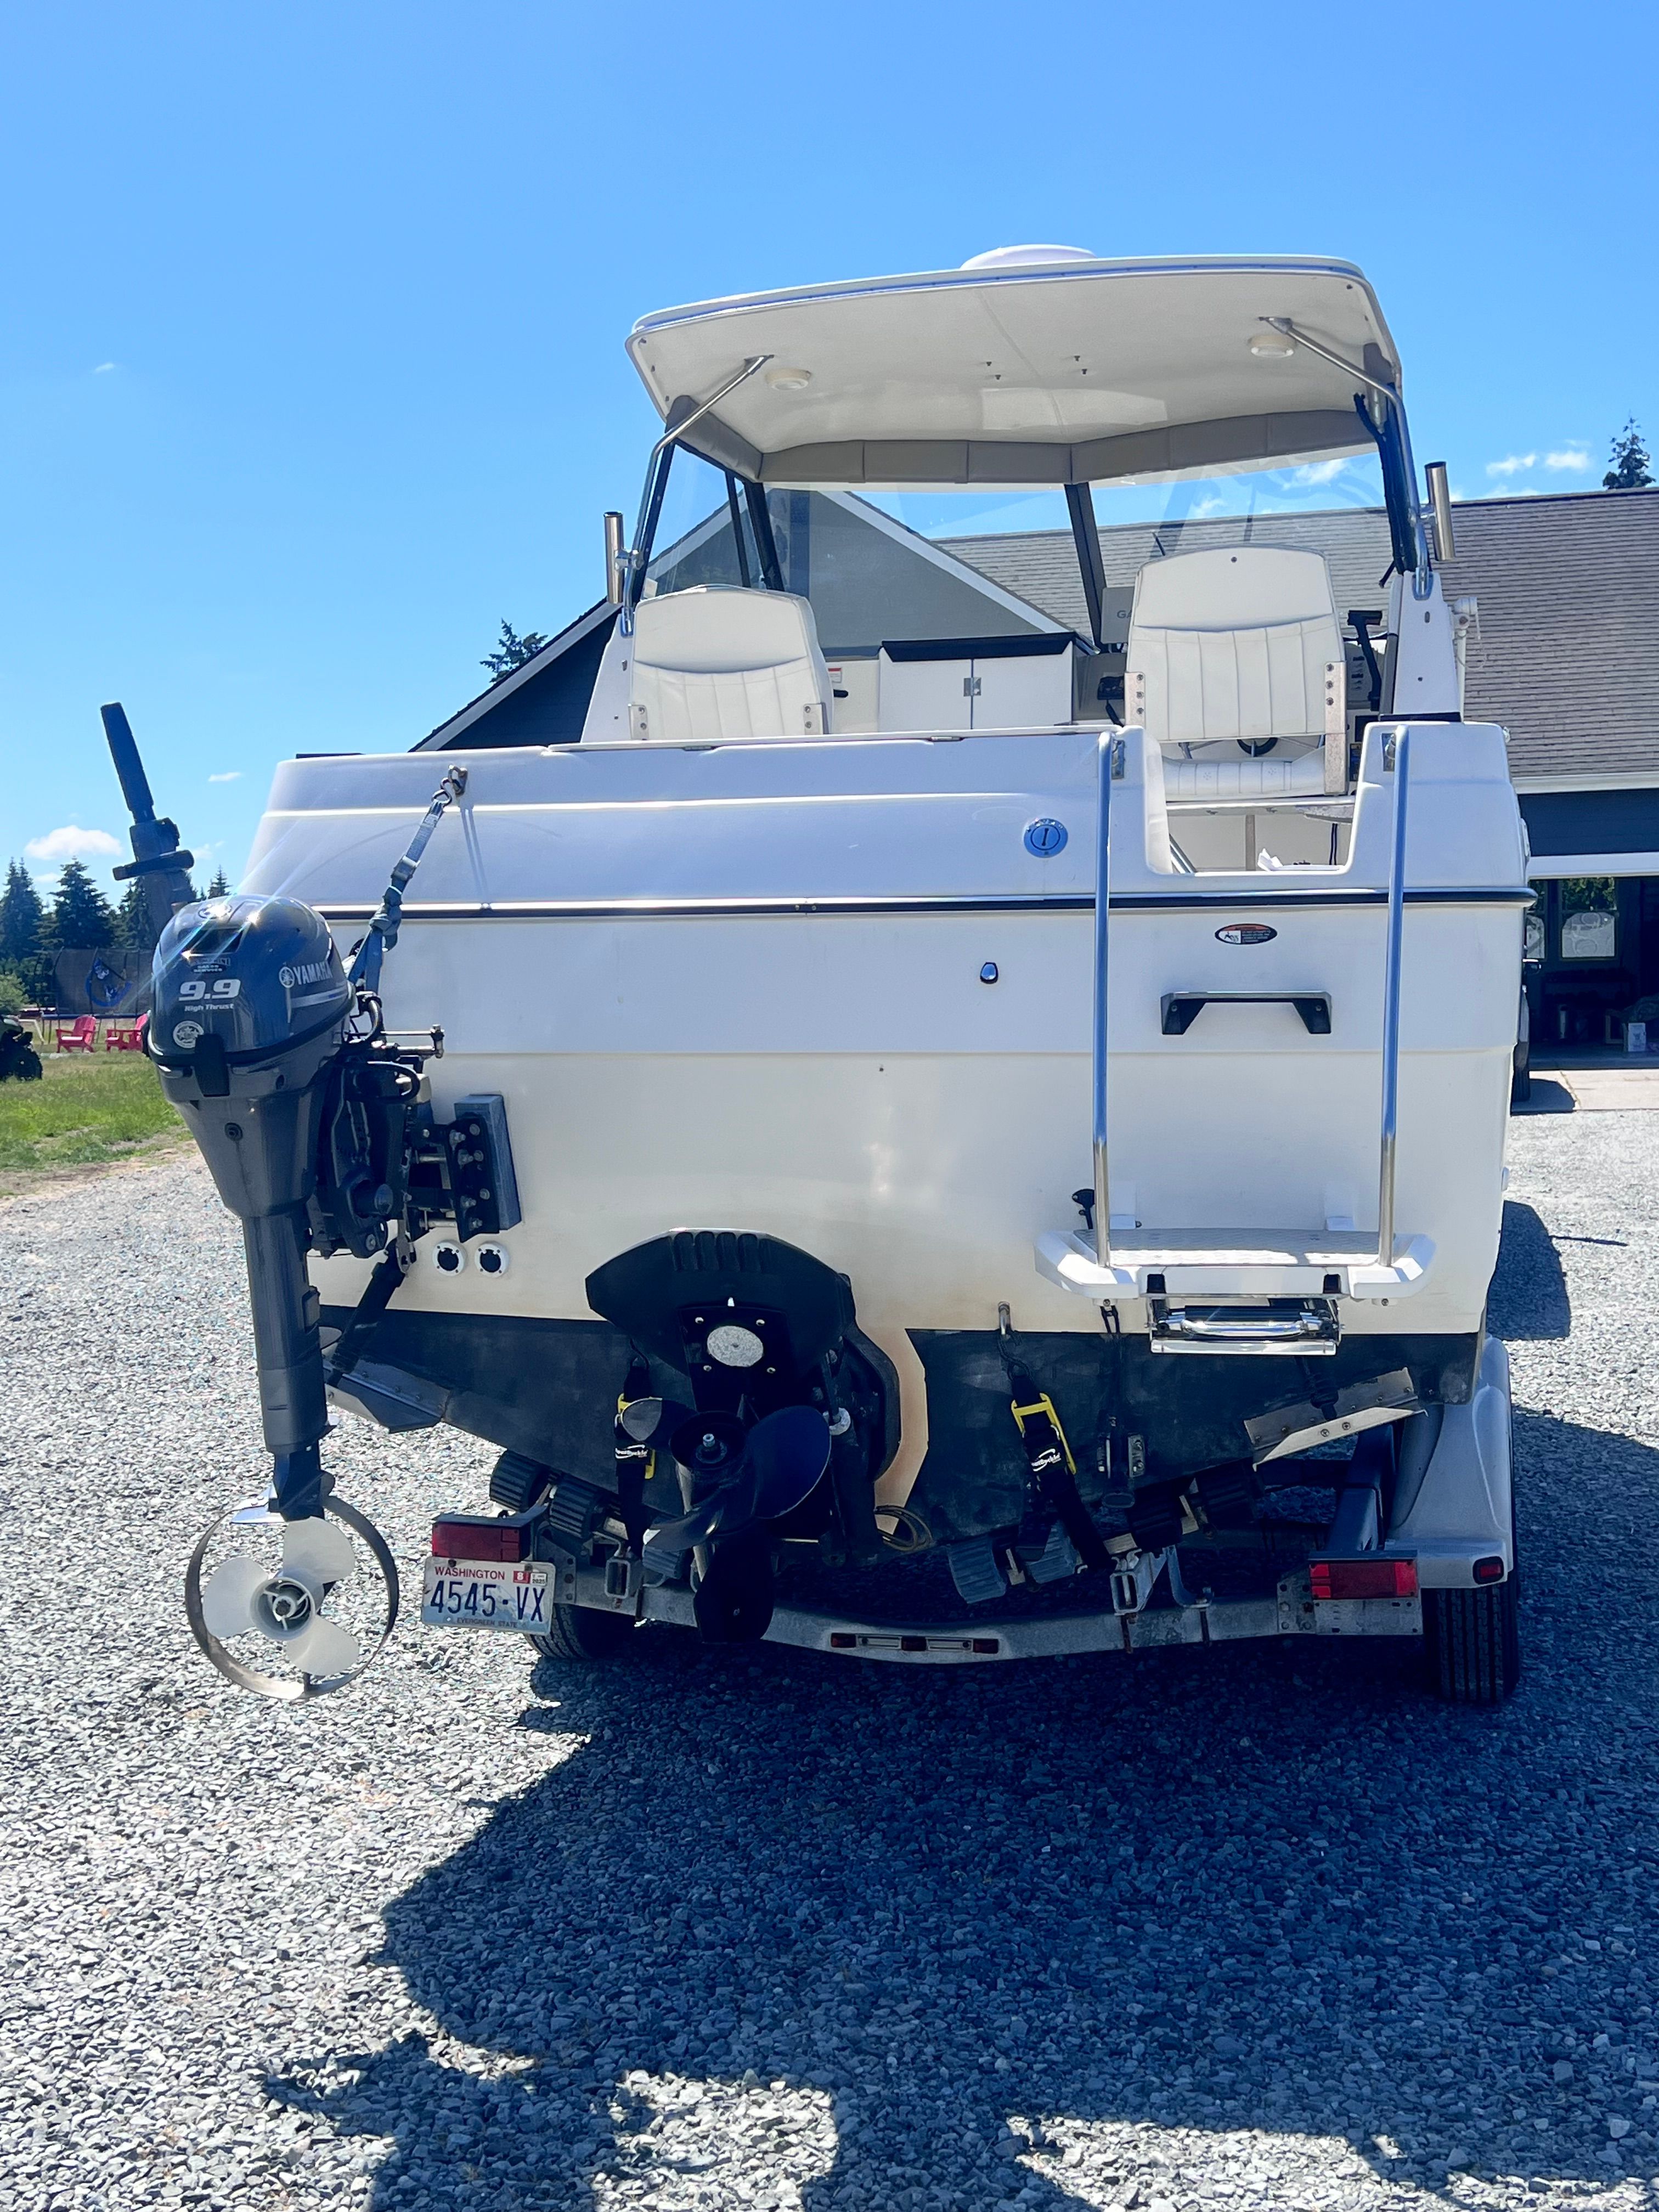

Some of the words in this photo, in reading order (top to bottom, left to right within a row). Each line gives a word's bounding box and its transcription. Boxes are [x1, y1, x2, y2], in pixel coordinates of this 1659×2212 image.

[292, 961, 333, 985] YAMAHA
[178, 979, 241, 1001] 9.9
[435, 1566, 505, 1580] WASHINGTON
[517, 1572, 524, 1580] 8
[456, 1617, 495, 1626] EVERGREEN
